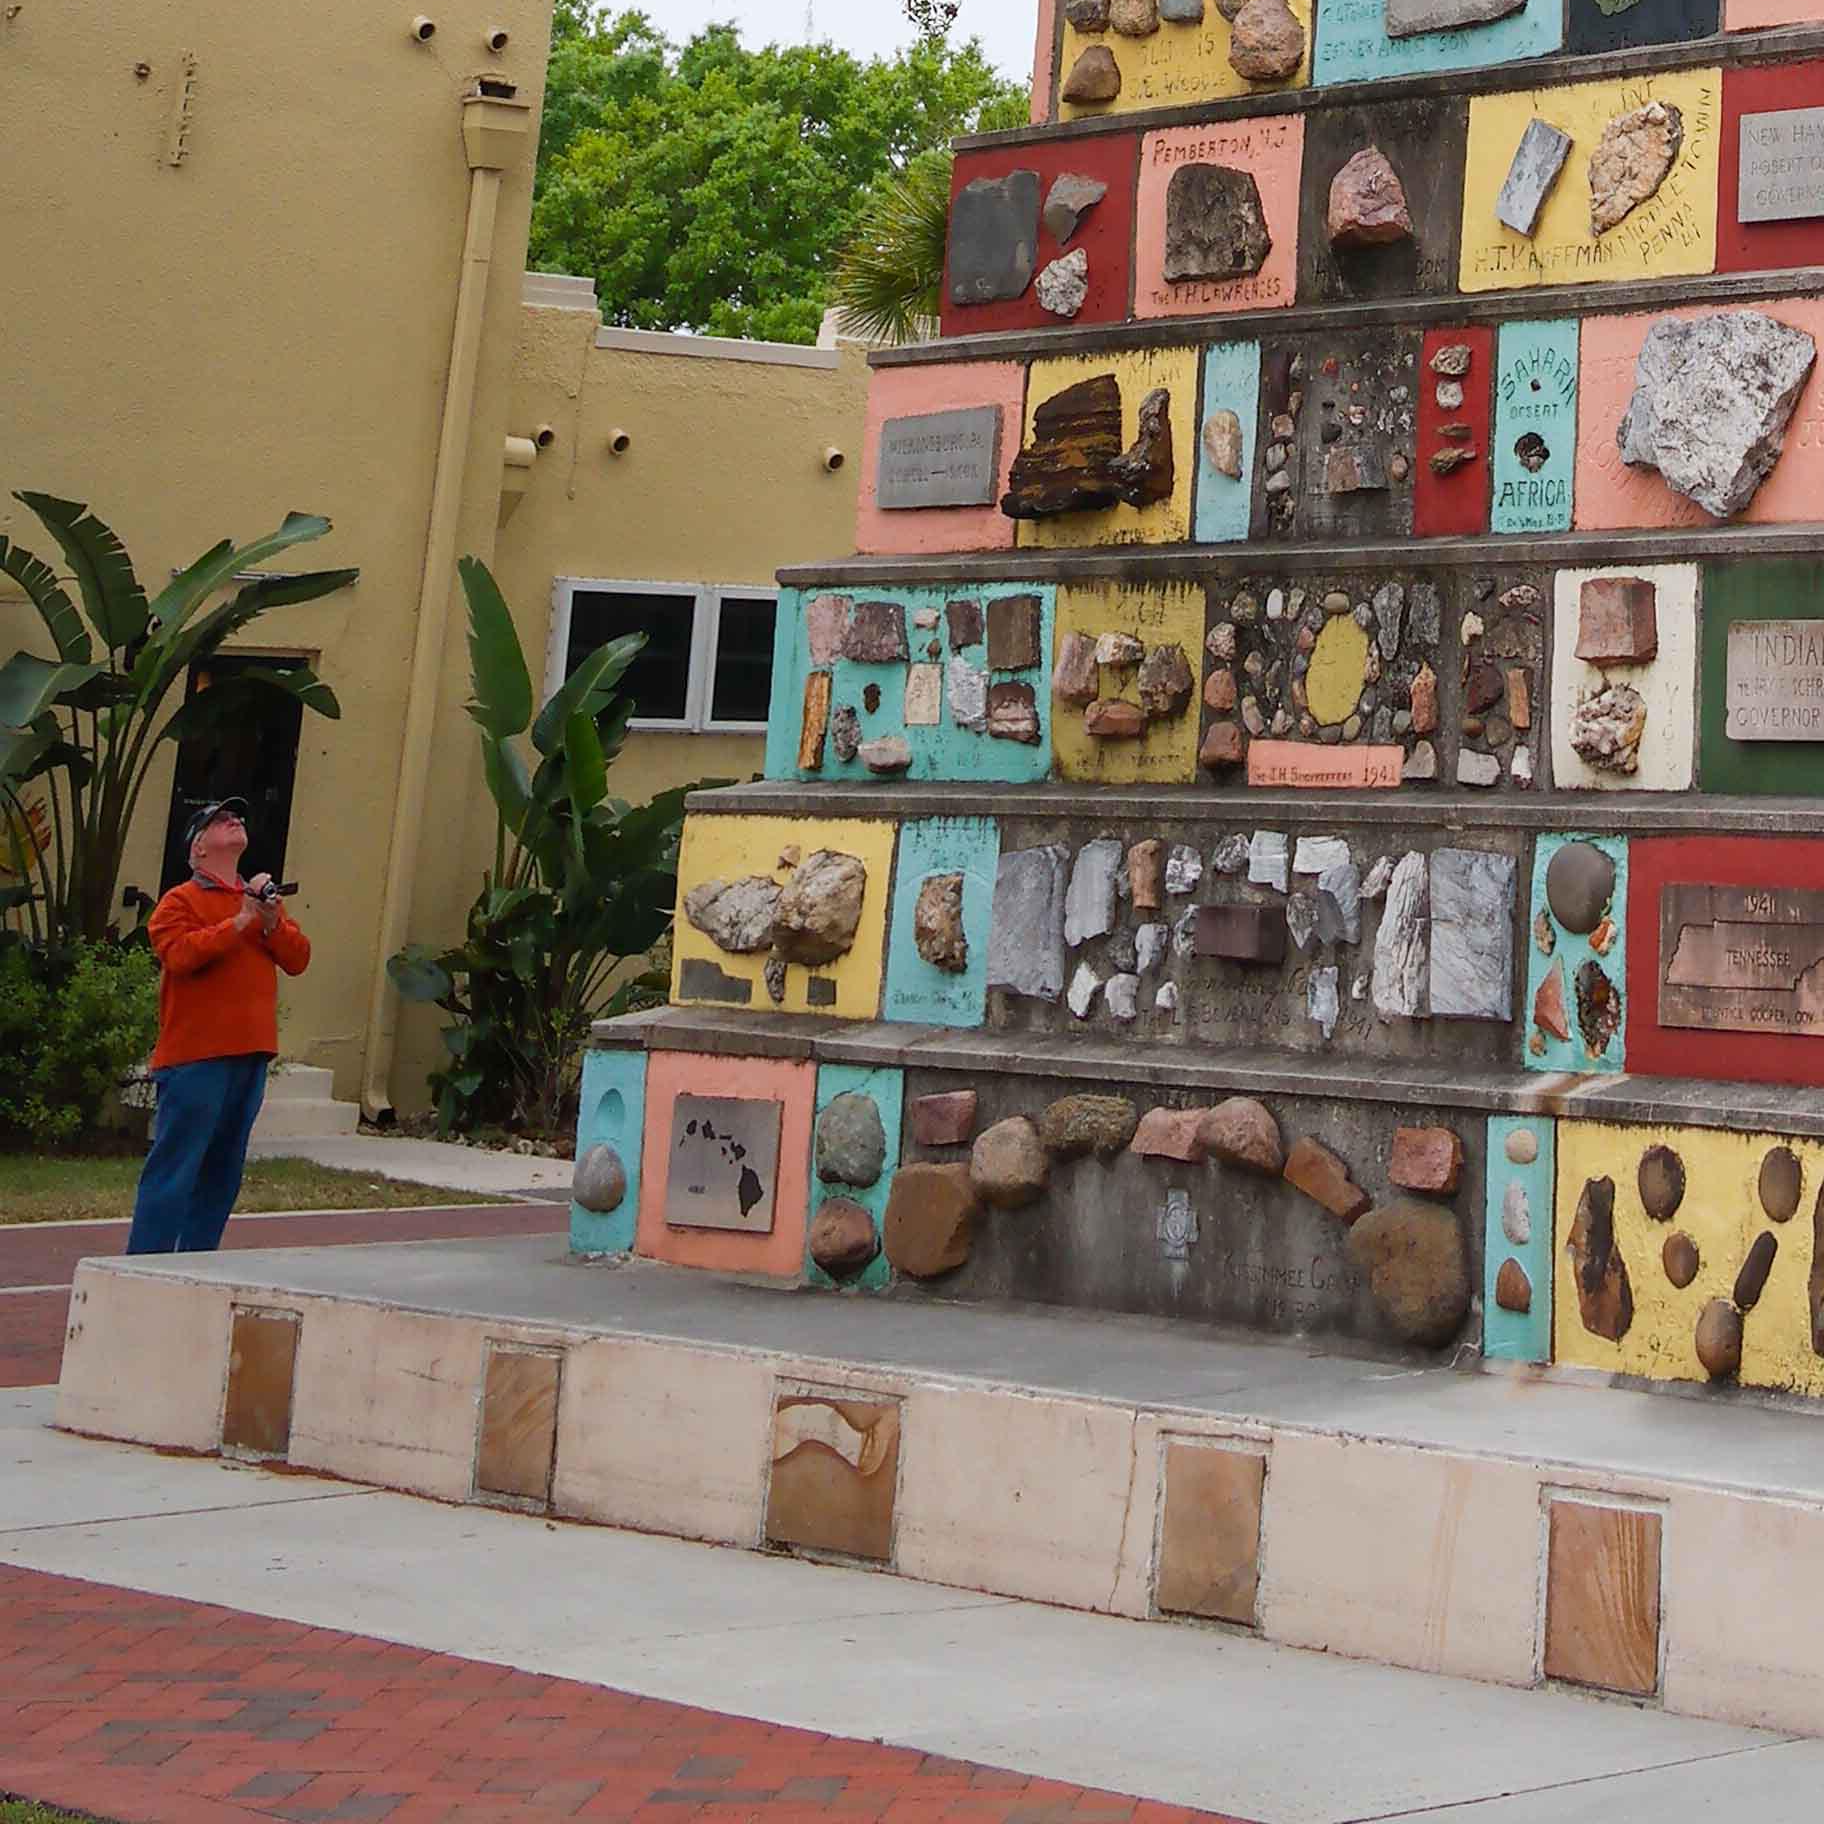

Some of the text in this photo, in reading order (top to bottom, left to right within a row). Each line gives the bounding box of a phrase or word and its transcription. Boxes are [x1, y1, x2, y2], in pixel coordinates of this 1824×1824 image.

[1746, 125, 1786, 147] NEW
[1750, 156, 1802, 176] ROBERT
[1500, 345, 1576, 408] SAHARA
[1498, 478, 1568, 509] AFRICA
[1735, 676, 1776, 698] HENRY
[1735, 706, 1822, 729] GOVERNOR
[1362, 766, 1397, 784] 1941
[1744, 894, 1777, 917] 1941
[1726, 949, 1792, 970] TENNESSEE
